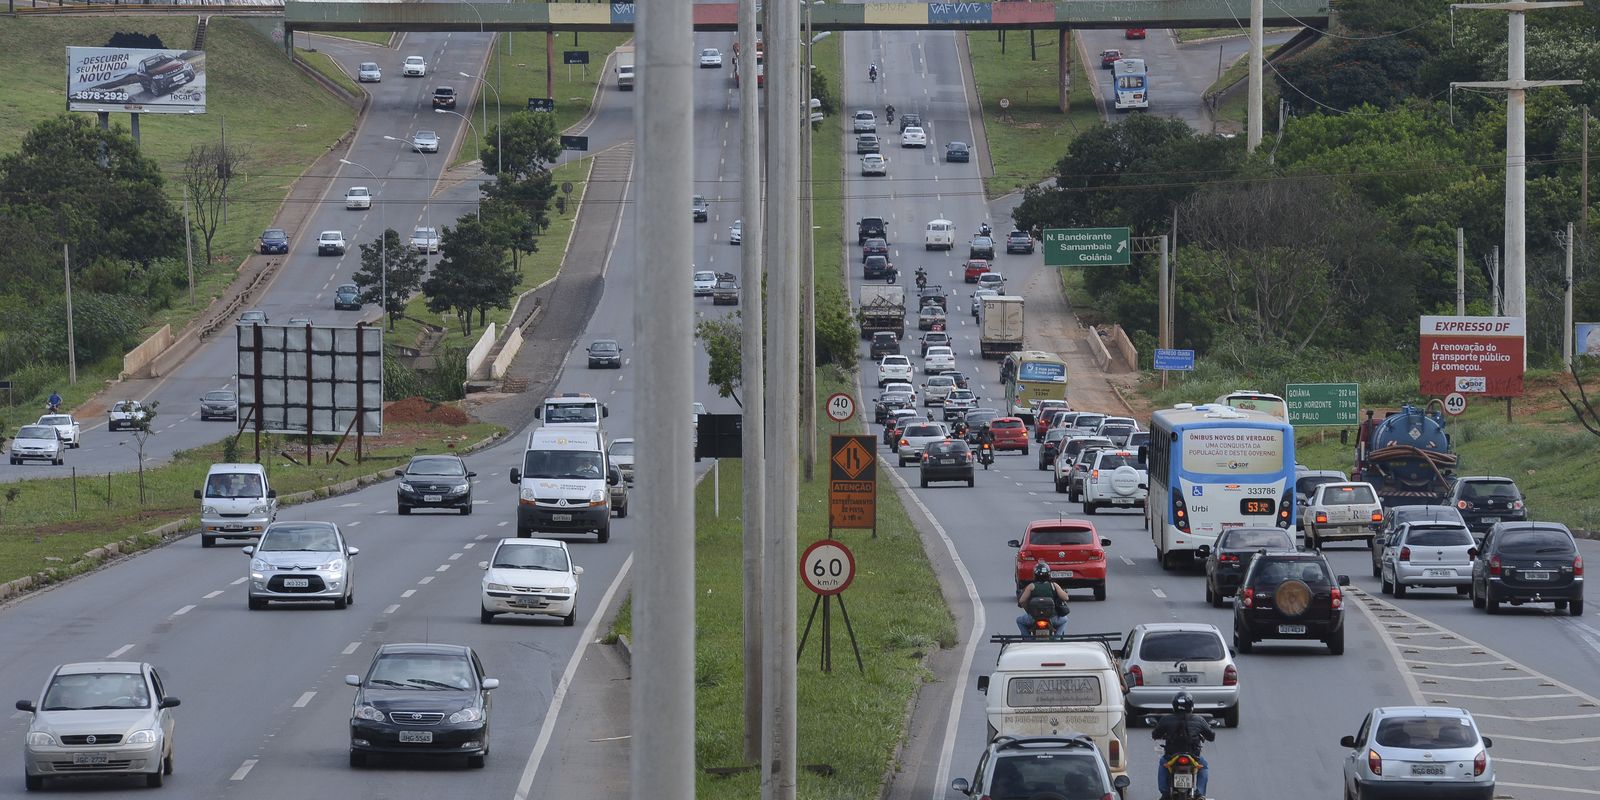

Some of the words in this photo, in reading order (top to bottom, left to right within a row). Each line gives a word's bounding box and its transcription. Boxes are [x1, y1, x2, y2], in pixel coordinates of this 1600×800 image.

[83, 53, 129, 65] DESCUBRA
[92, 62, 127, 72] MUNDO
[79, 72, 111, 83] NOVO
[76, 92, 129, 100] 3878-2929
[169, 93, 191, 101] Tecar
[1058, 233, 1112, 241] Bandeirante
[1060, 243, 1112, 251] Samambaia
[1079, 253, 1113, 261] Goiânia
[1435, 322, 1493, 332] EXPRESSO
[1495, 322, 1510, 332] DF
[1432, 342, 1439, 351] A
[1440, 342, 1484, 353] renovação
[1486, 343, 1497, 352] do
[1432, 352, 1478, 362] transporte
[1479, 352, 1511, 363] público
[1431, 362, 1440, 372] já
[1441, 363, 1482, 372] começou.
[1289, 388, 1311, 397] GOIÂNIA
[1349, 389, 1356, 397] km
[833, 398, 848, 408] 40
[1289, 401, 1302, 409] BELO
[1448, 397, 1464, 407] 40
[1289, 411, 1299, 420] SÃO
[1349, 412, 1356, 420] km
[1189, 432, 1214, 441] ÔNIBUS
[834, 481, 871, 492] ATENÇÃO
[1191, 505, 1209, 513] Urbi
[1248, 502, 1259, 513] 53
[813, 558, 842, 577] 60
[817, 578, 838, 587] km/h
